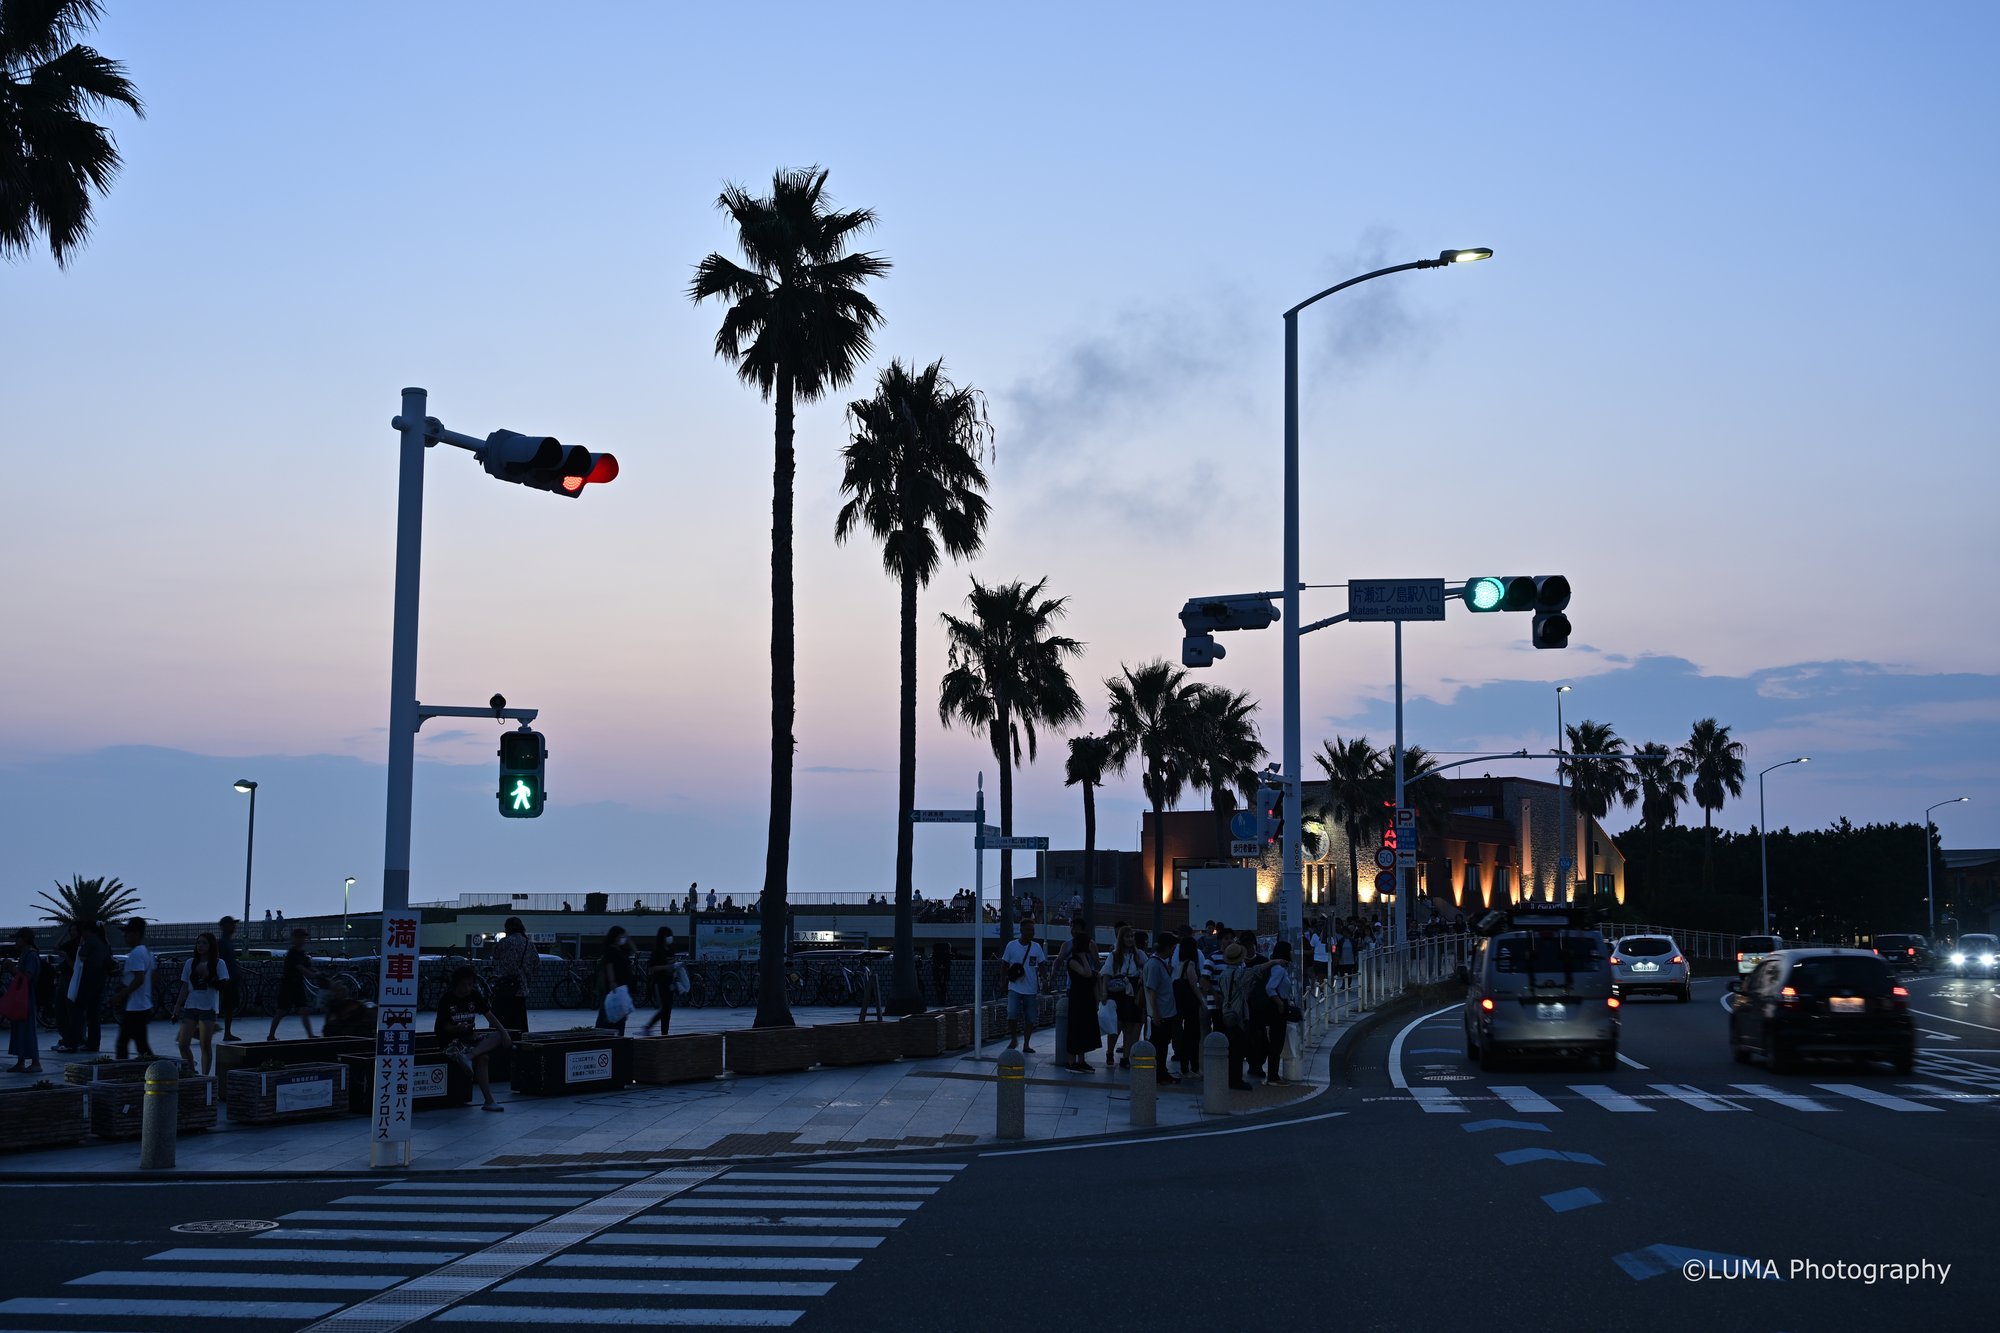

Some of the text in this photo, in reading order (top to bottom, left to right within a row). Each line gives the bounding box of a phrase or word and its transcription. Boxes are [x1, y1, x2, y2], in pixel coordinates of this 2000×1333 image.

[1353, 585, 1441, 603] 片瀬江ノ島駅入口
[1398, 809, 1413, 826] P
[1233, 843, 1257, 853] 歩行者優先
[1380, 852, 1393, 864] 50
[387, 918, 416, 982] 満車
[385, 987, 413, 996] FULL
[378, 1070, 393, 1139] マイクロバス
[396, 1070, 409, 1122] 大型バス
